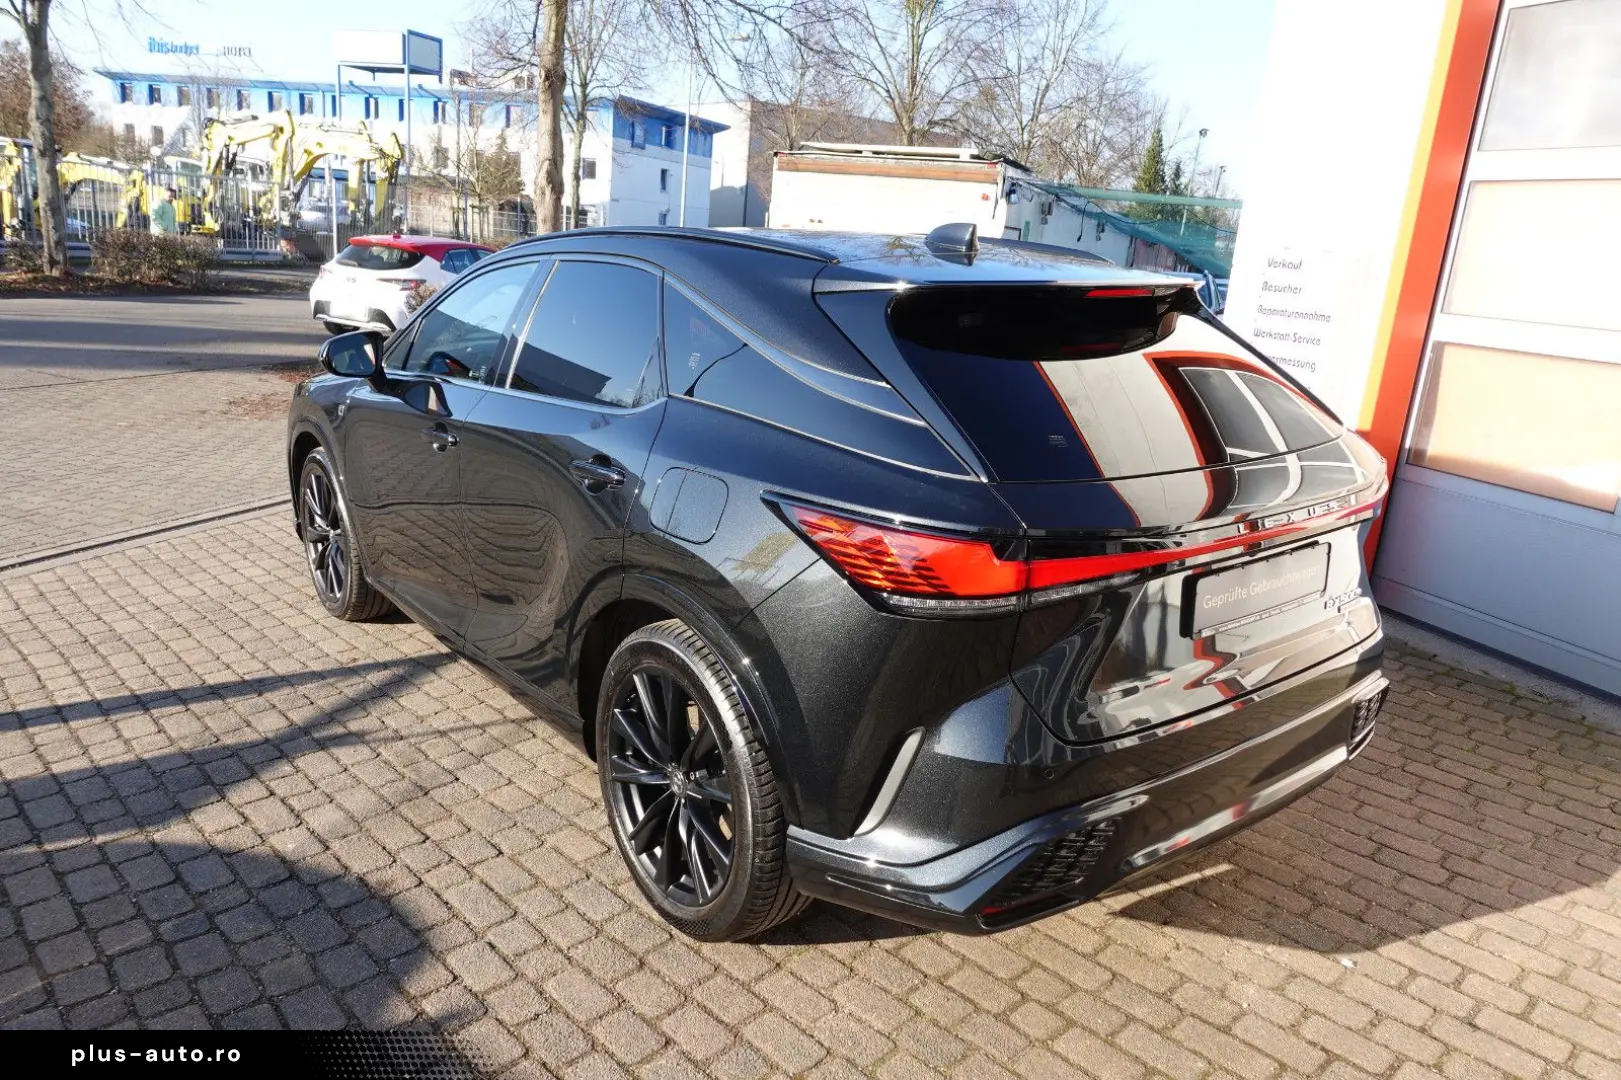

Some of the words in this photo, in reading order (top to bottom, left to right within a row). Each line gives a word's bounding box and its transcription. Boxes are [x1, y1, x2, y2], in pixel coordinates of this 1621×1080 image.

[1267, 257, 1303, 270] Verkauf
[1262, 281, 1302, 294] Besucher
[1203, 586, 1248, 609] Geprüfte
